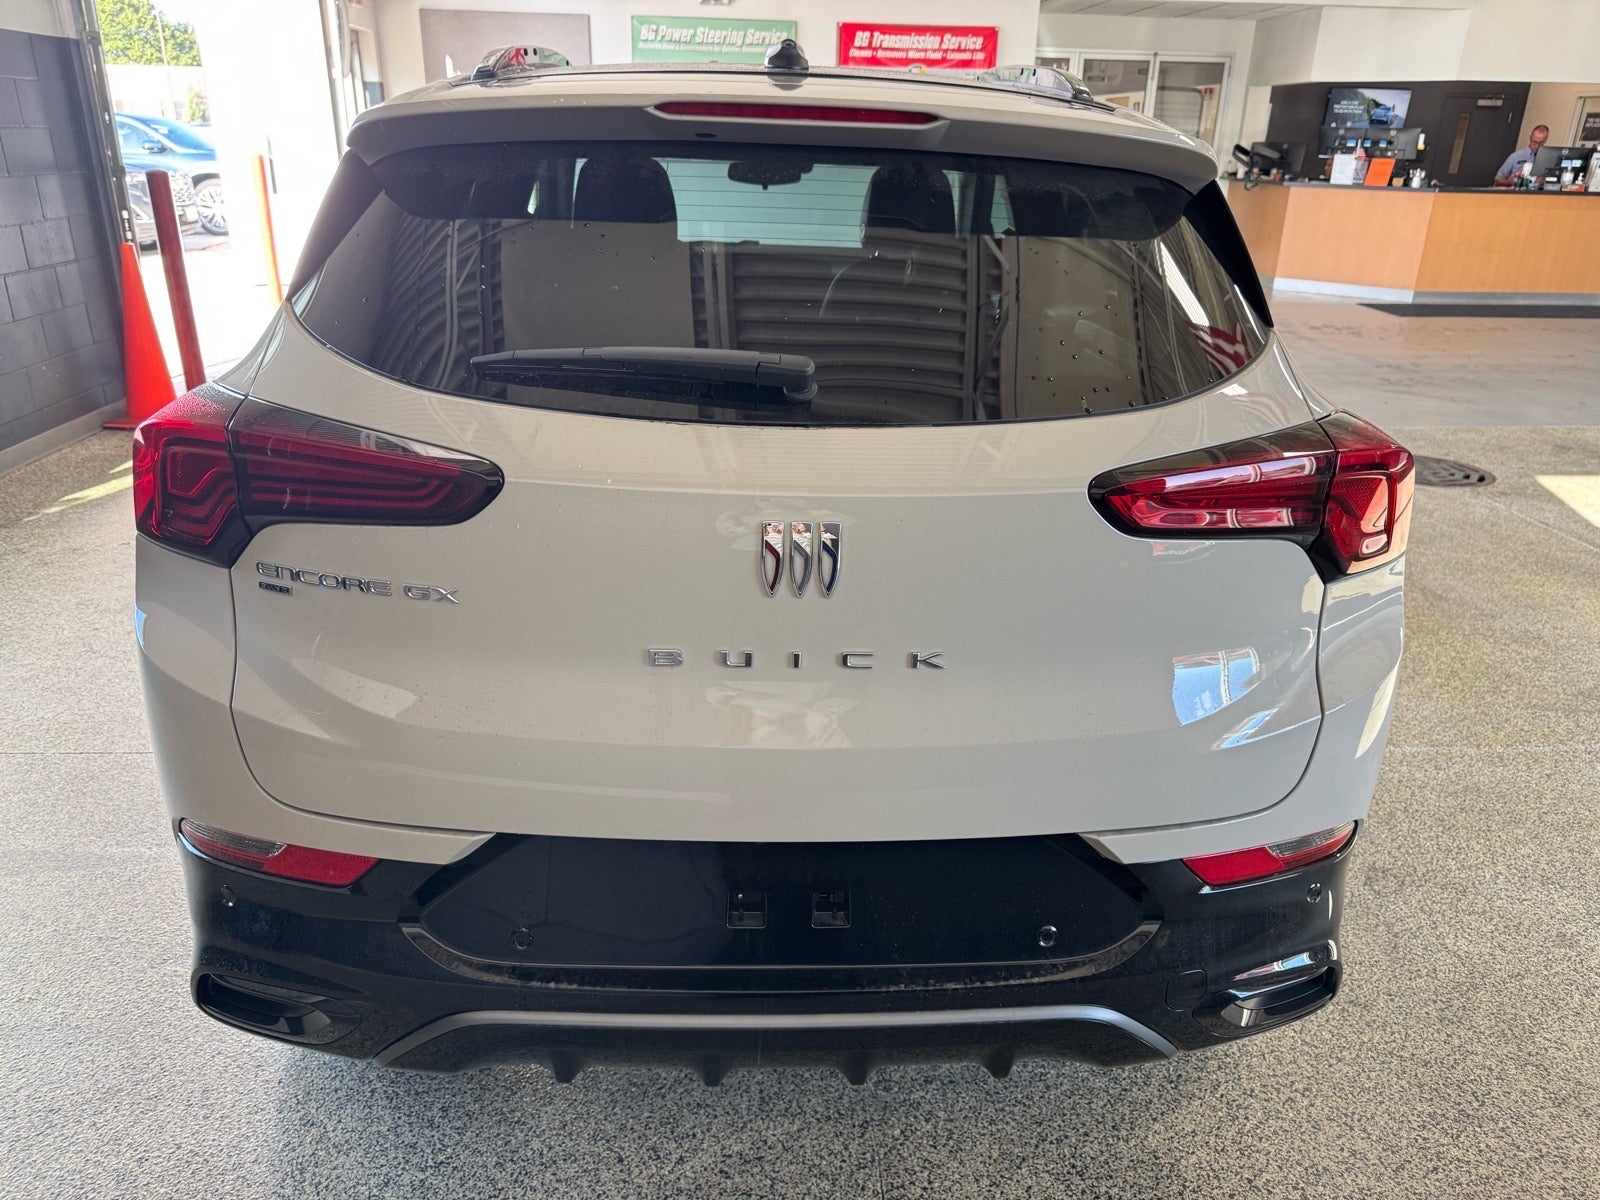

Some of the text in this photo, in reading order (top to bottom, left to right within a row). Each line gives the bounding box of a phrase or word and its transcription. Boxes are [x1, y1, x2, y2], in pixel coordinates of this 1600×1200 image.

[640, 24, 788, 47] BG Power Steering Service
[853, 31, 984, 50] BG Transmission Service
[256, 560, 462, 605] ENCORE GX
[647, 648, 947, 670] BUICK
